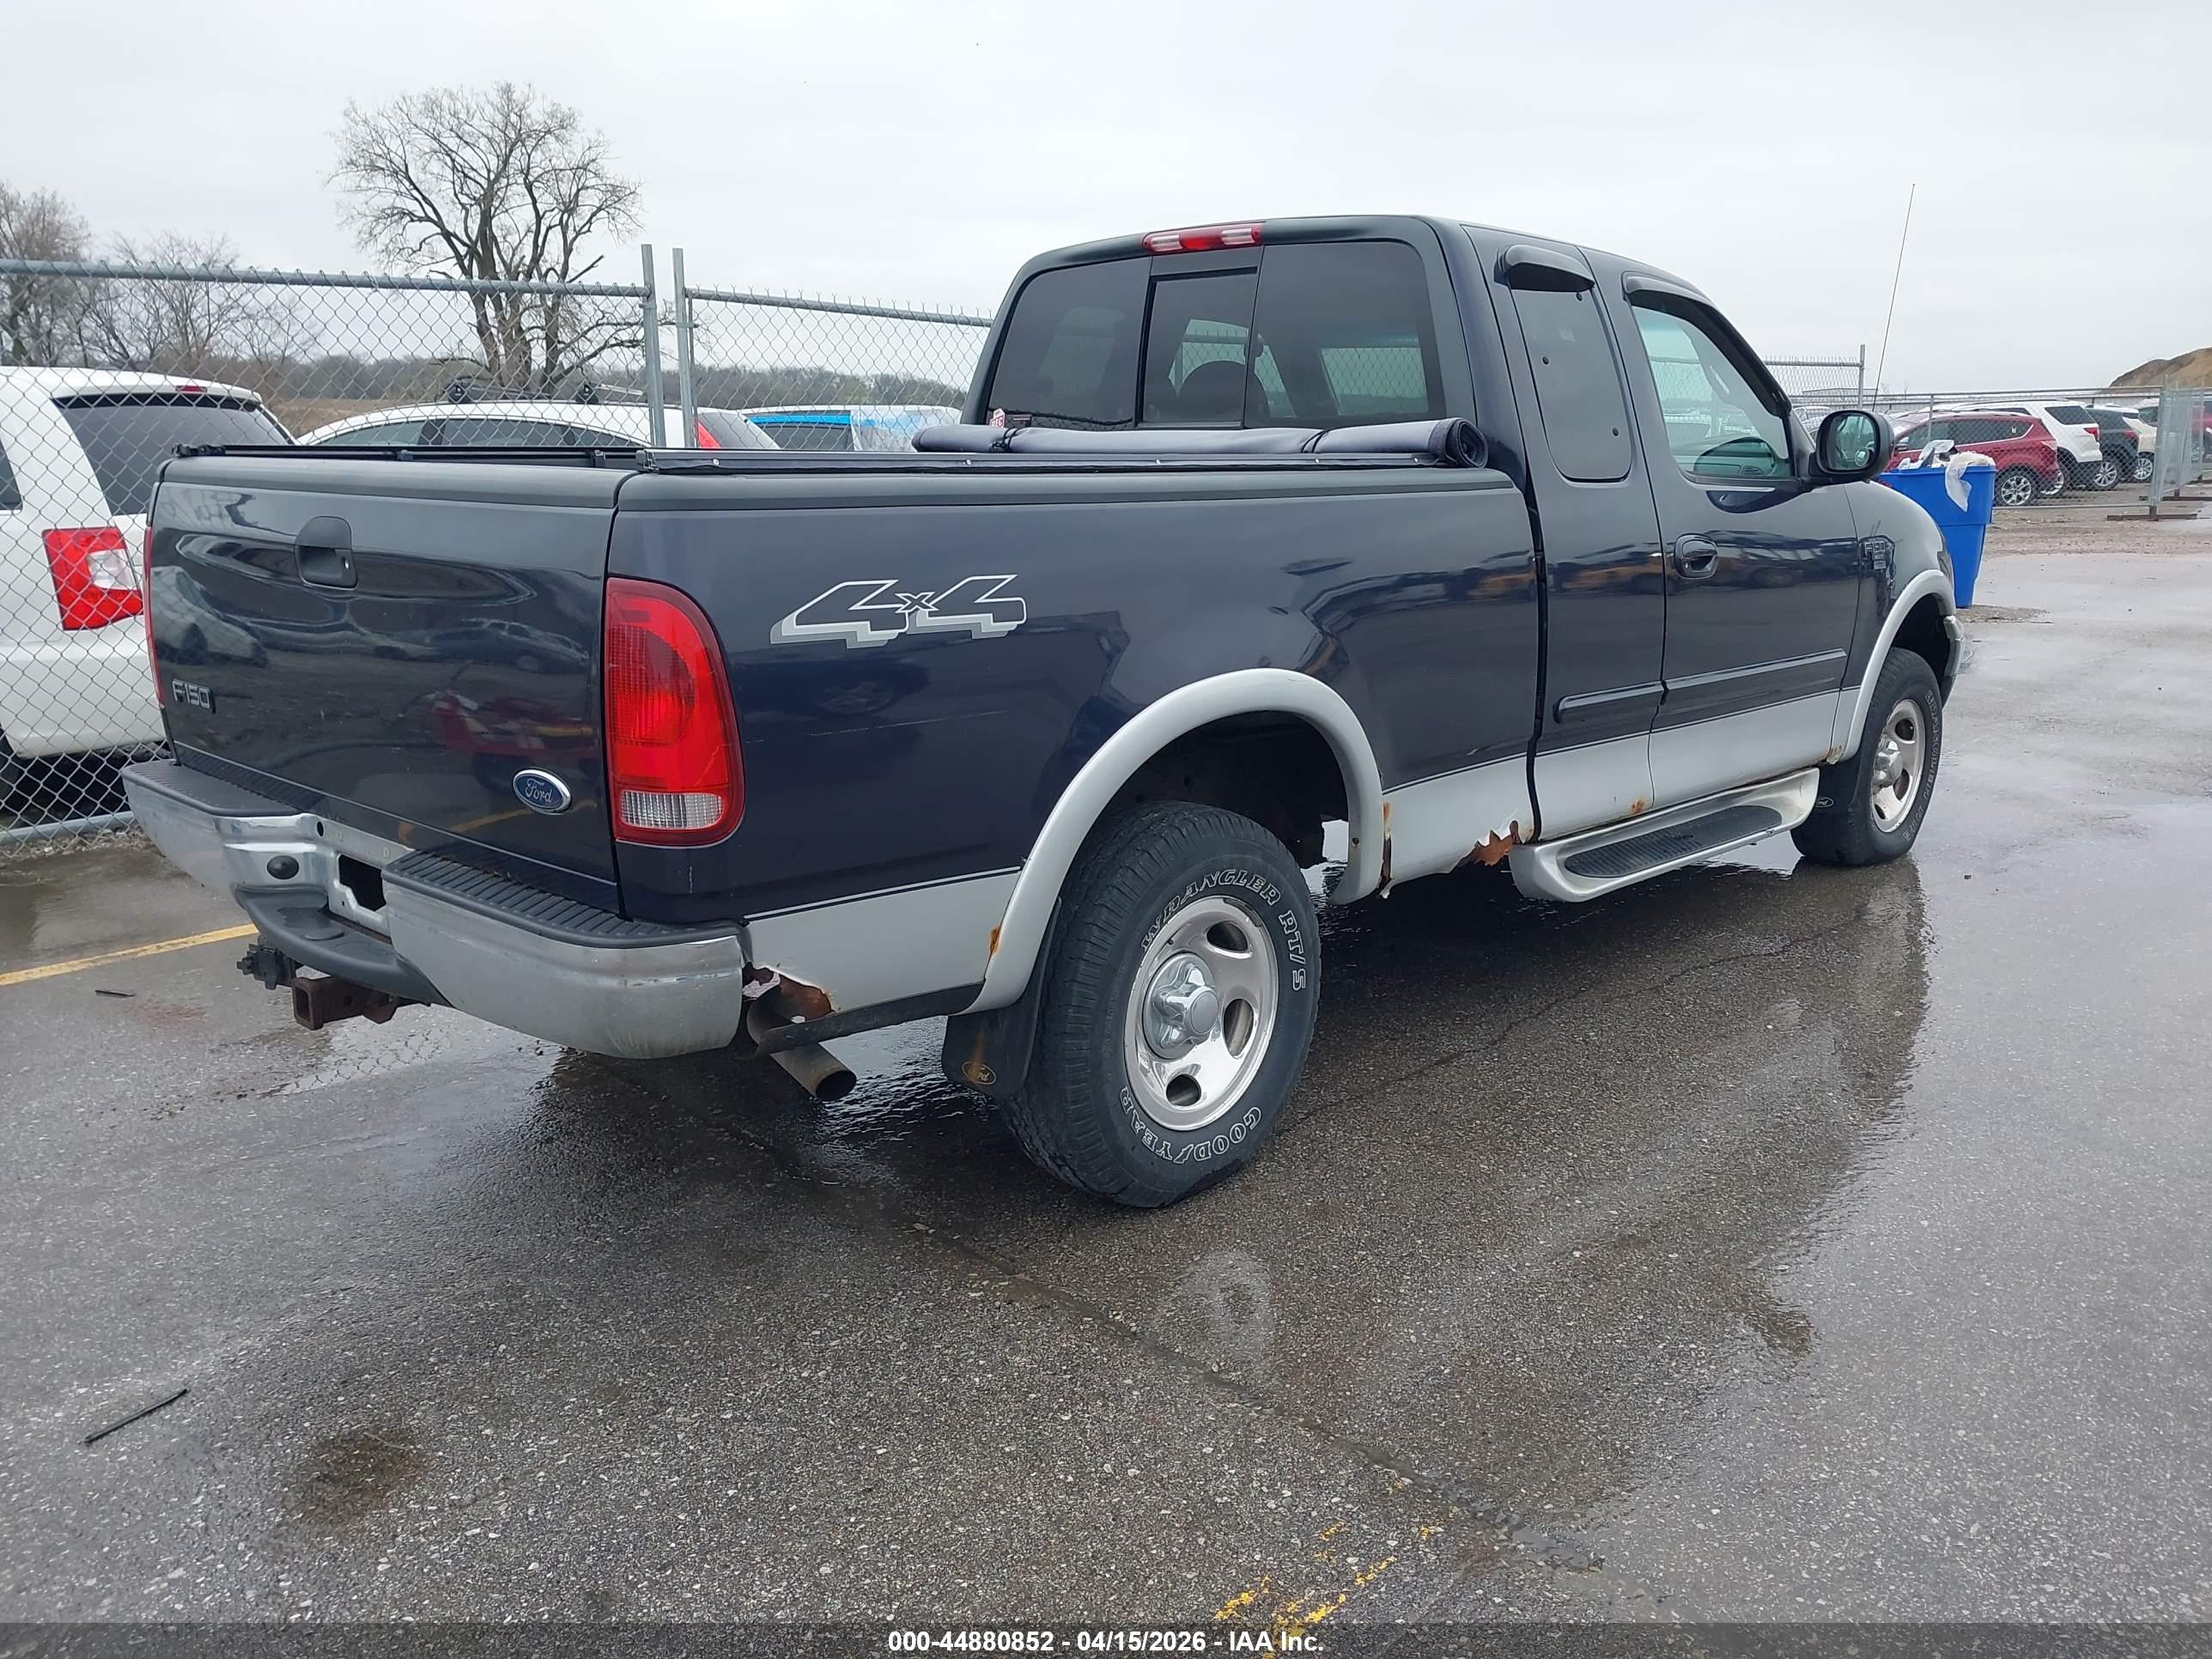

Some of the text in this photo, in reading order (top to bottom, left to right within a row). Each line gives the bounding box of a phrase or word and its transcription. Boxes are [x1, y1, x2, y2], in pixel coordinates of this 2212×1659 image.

[525, 778, 553, 804] Ford
[1140, 868, 1306, 991] WRANGLER RT/S
